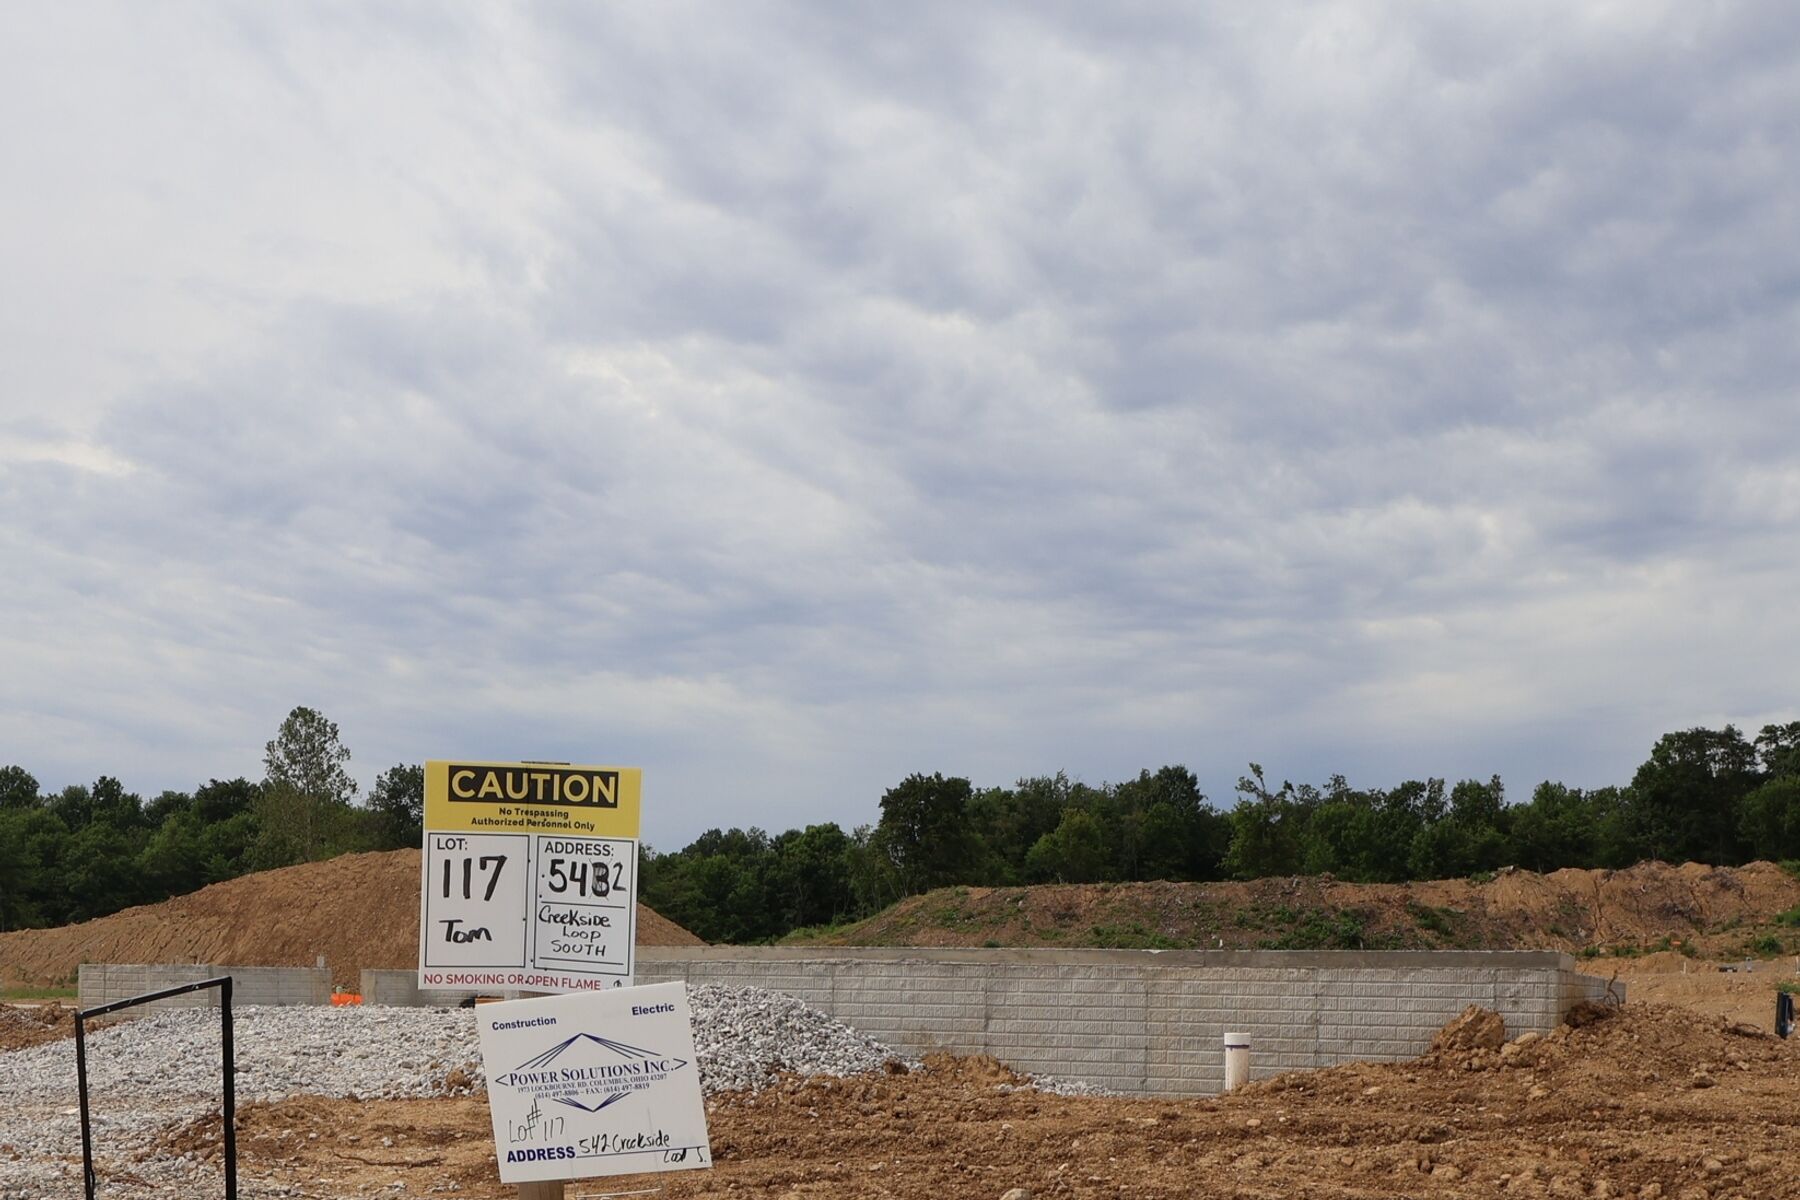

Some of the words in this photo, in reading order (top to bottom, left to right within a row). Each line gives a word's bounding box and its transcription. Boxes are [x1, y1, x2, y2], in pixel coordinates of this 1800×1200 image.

[451, 769, 616, 804] CAUTION
[499, 807, 512, 816] No
[514, 808, 569, 819] Trespassing
[471, 817, 525, 826] Authorized
[526, 818, 572, 829] Personnel
[574, 821, 595, 832] Only
[437, 838, 468, 851] LOT:
[544, 841, 614, 857] ADDRESS:
[443, 855, 508, 901] 117
[439, 919, 493, 944] Tom
[551, 940, 606, 957] SOUTH
[424, 974, 443, 985] NO
[446, 974, 505, 985] SMOKING
[527, 975, 558, 988] OPEN
[562, 978, 601, 991] FLAME
[632, 1003, 675, 1016] Electric
[492, 1016, 557, 1031] Construction
[509, 1072, 558, 1086] POWER
[561, 1062, 641, 1082] SOLUTIONS
[644, 1059, 674, 1074] INC.
[630, 1075, 649, 1083] OHIO
[650, 1073, 668, 1081] 43207
[578, 1134, 610, 1154] 542
[507, 1146, 576, 1162] ADDRESS
